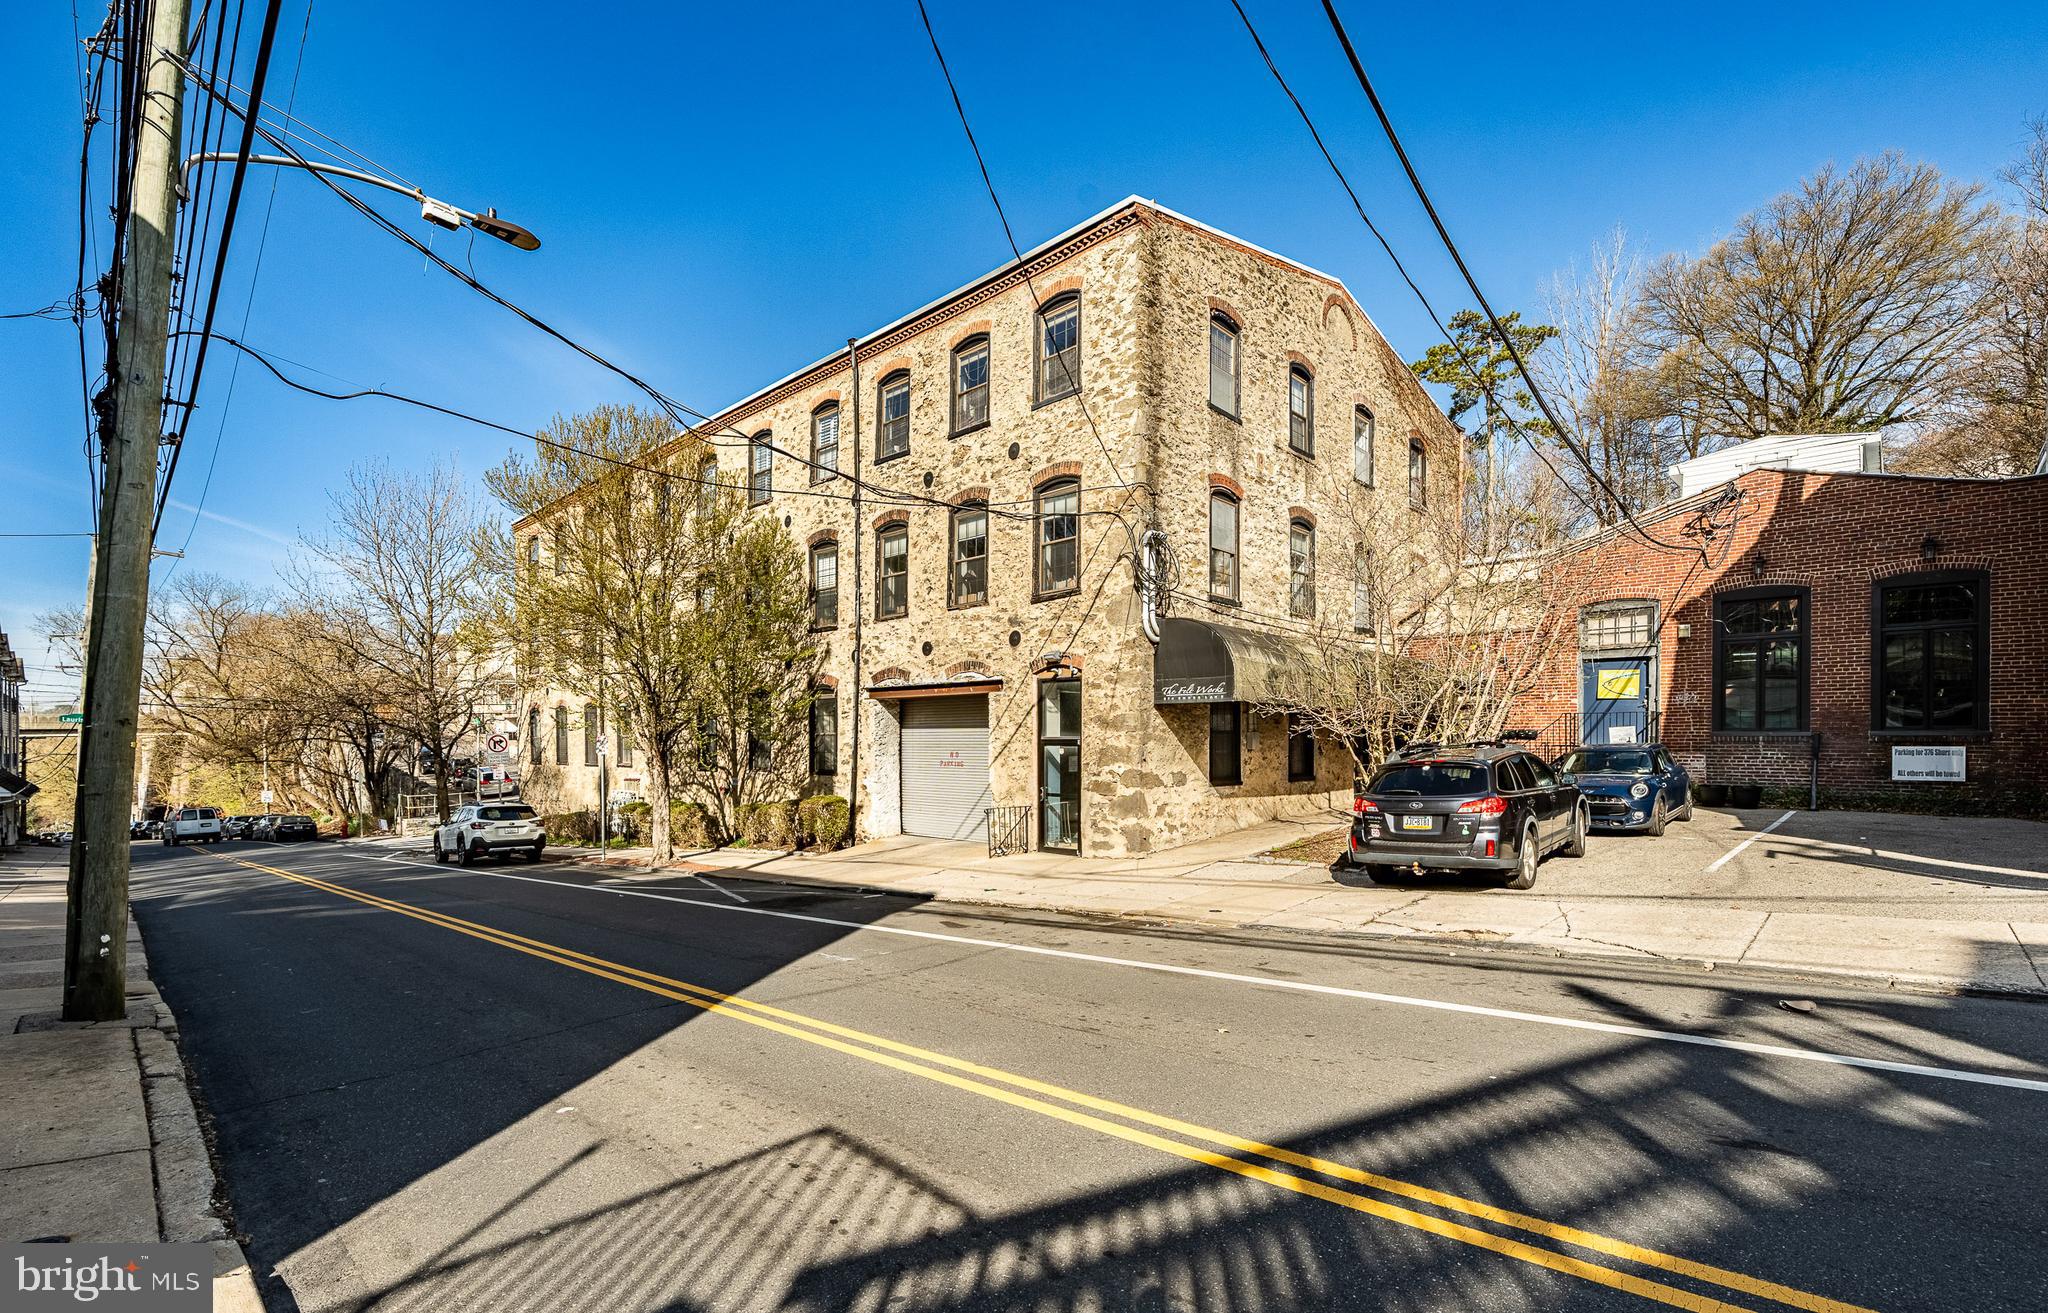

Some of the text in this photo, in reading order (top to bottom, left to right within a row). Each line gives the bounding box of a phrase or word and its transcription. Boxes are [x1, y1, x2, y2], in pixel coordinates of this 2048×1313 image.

[1161, 683, 1179, 695] The
[1196, 682, 1226, 694] Works
[1894, 748, 1915, 756] Parking
[1915, 748, 1924, 756] for
